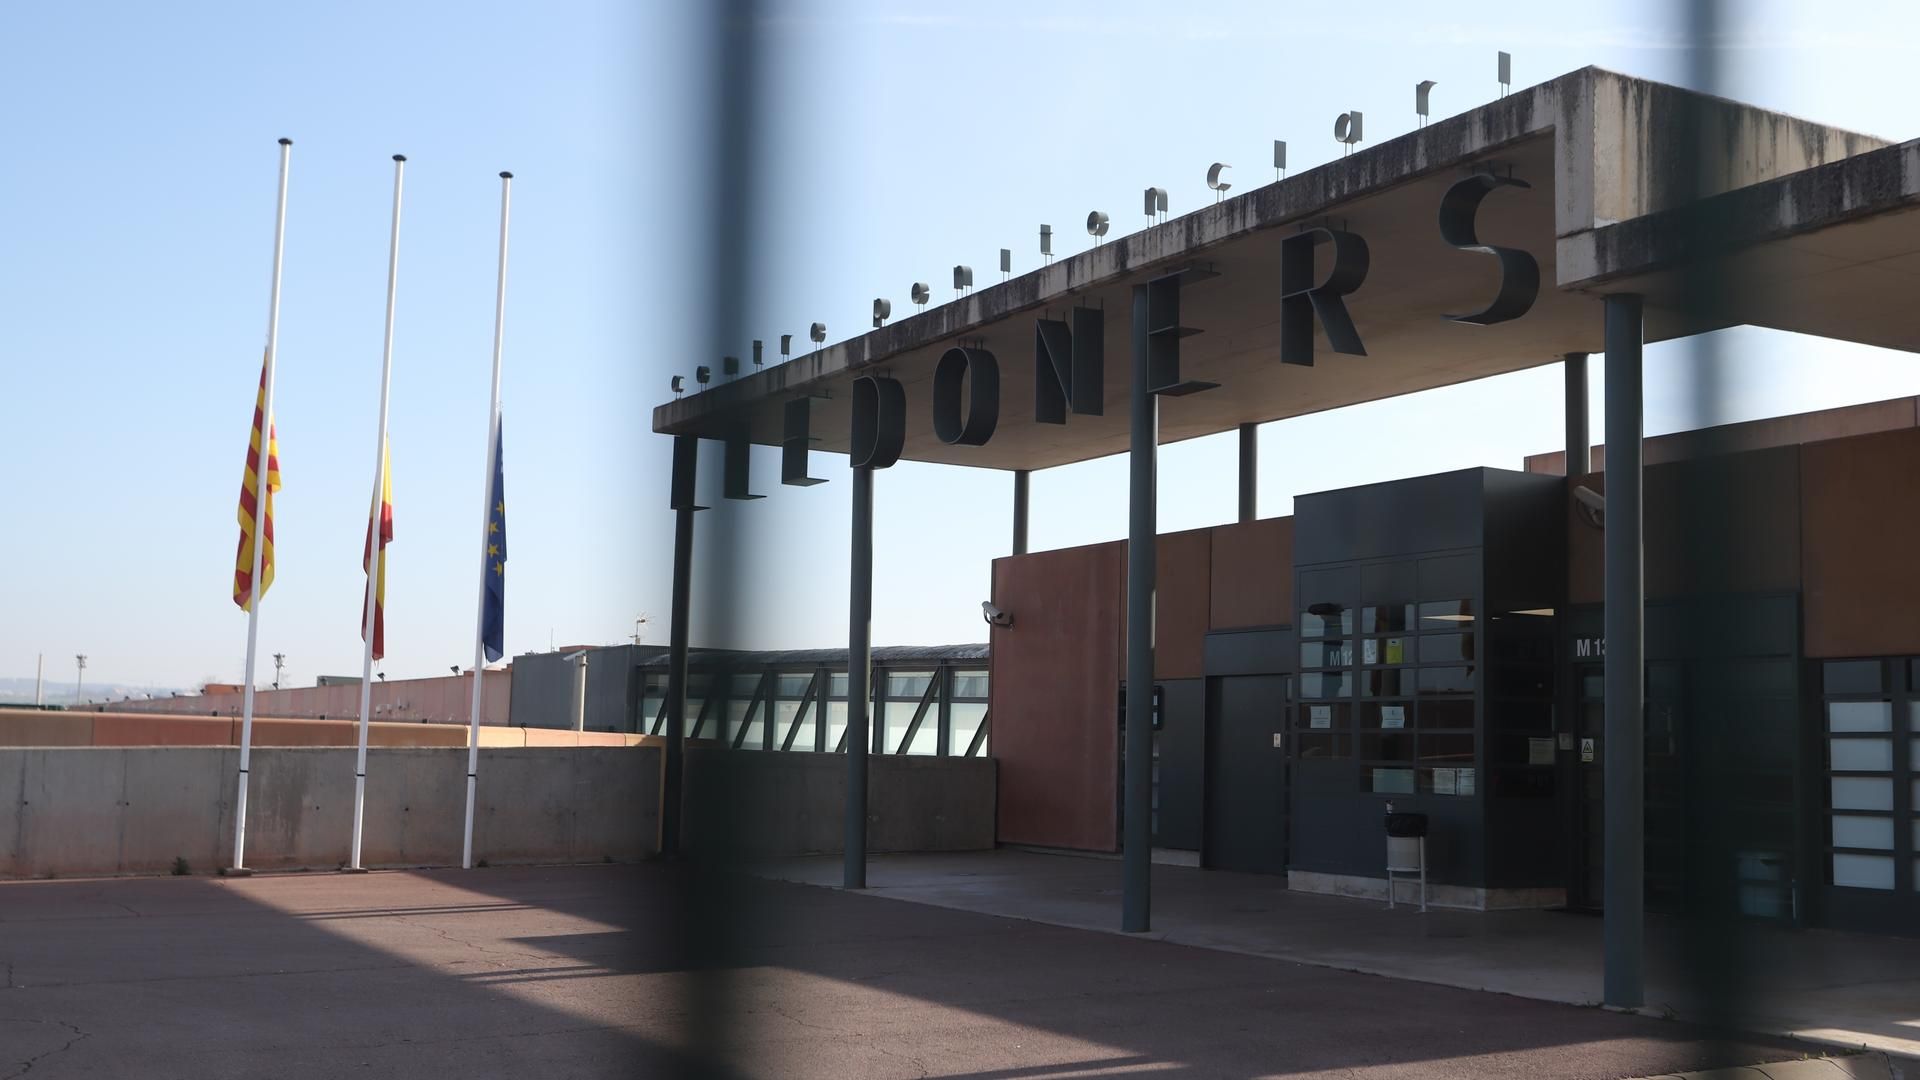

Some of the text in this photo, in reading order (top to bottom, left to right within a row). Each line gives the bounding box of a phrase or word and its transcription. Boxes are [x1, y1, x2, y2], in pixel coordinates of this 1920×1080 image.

[873, 50, 1511, 328] penitenciari
[670, 172, 1541, 511] LLEDONERS
[1329, 650, 1341, 667] M
[1576, 638, 1591, 657] M
